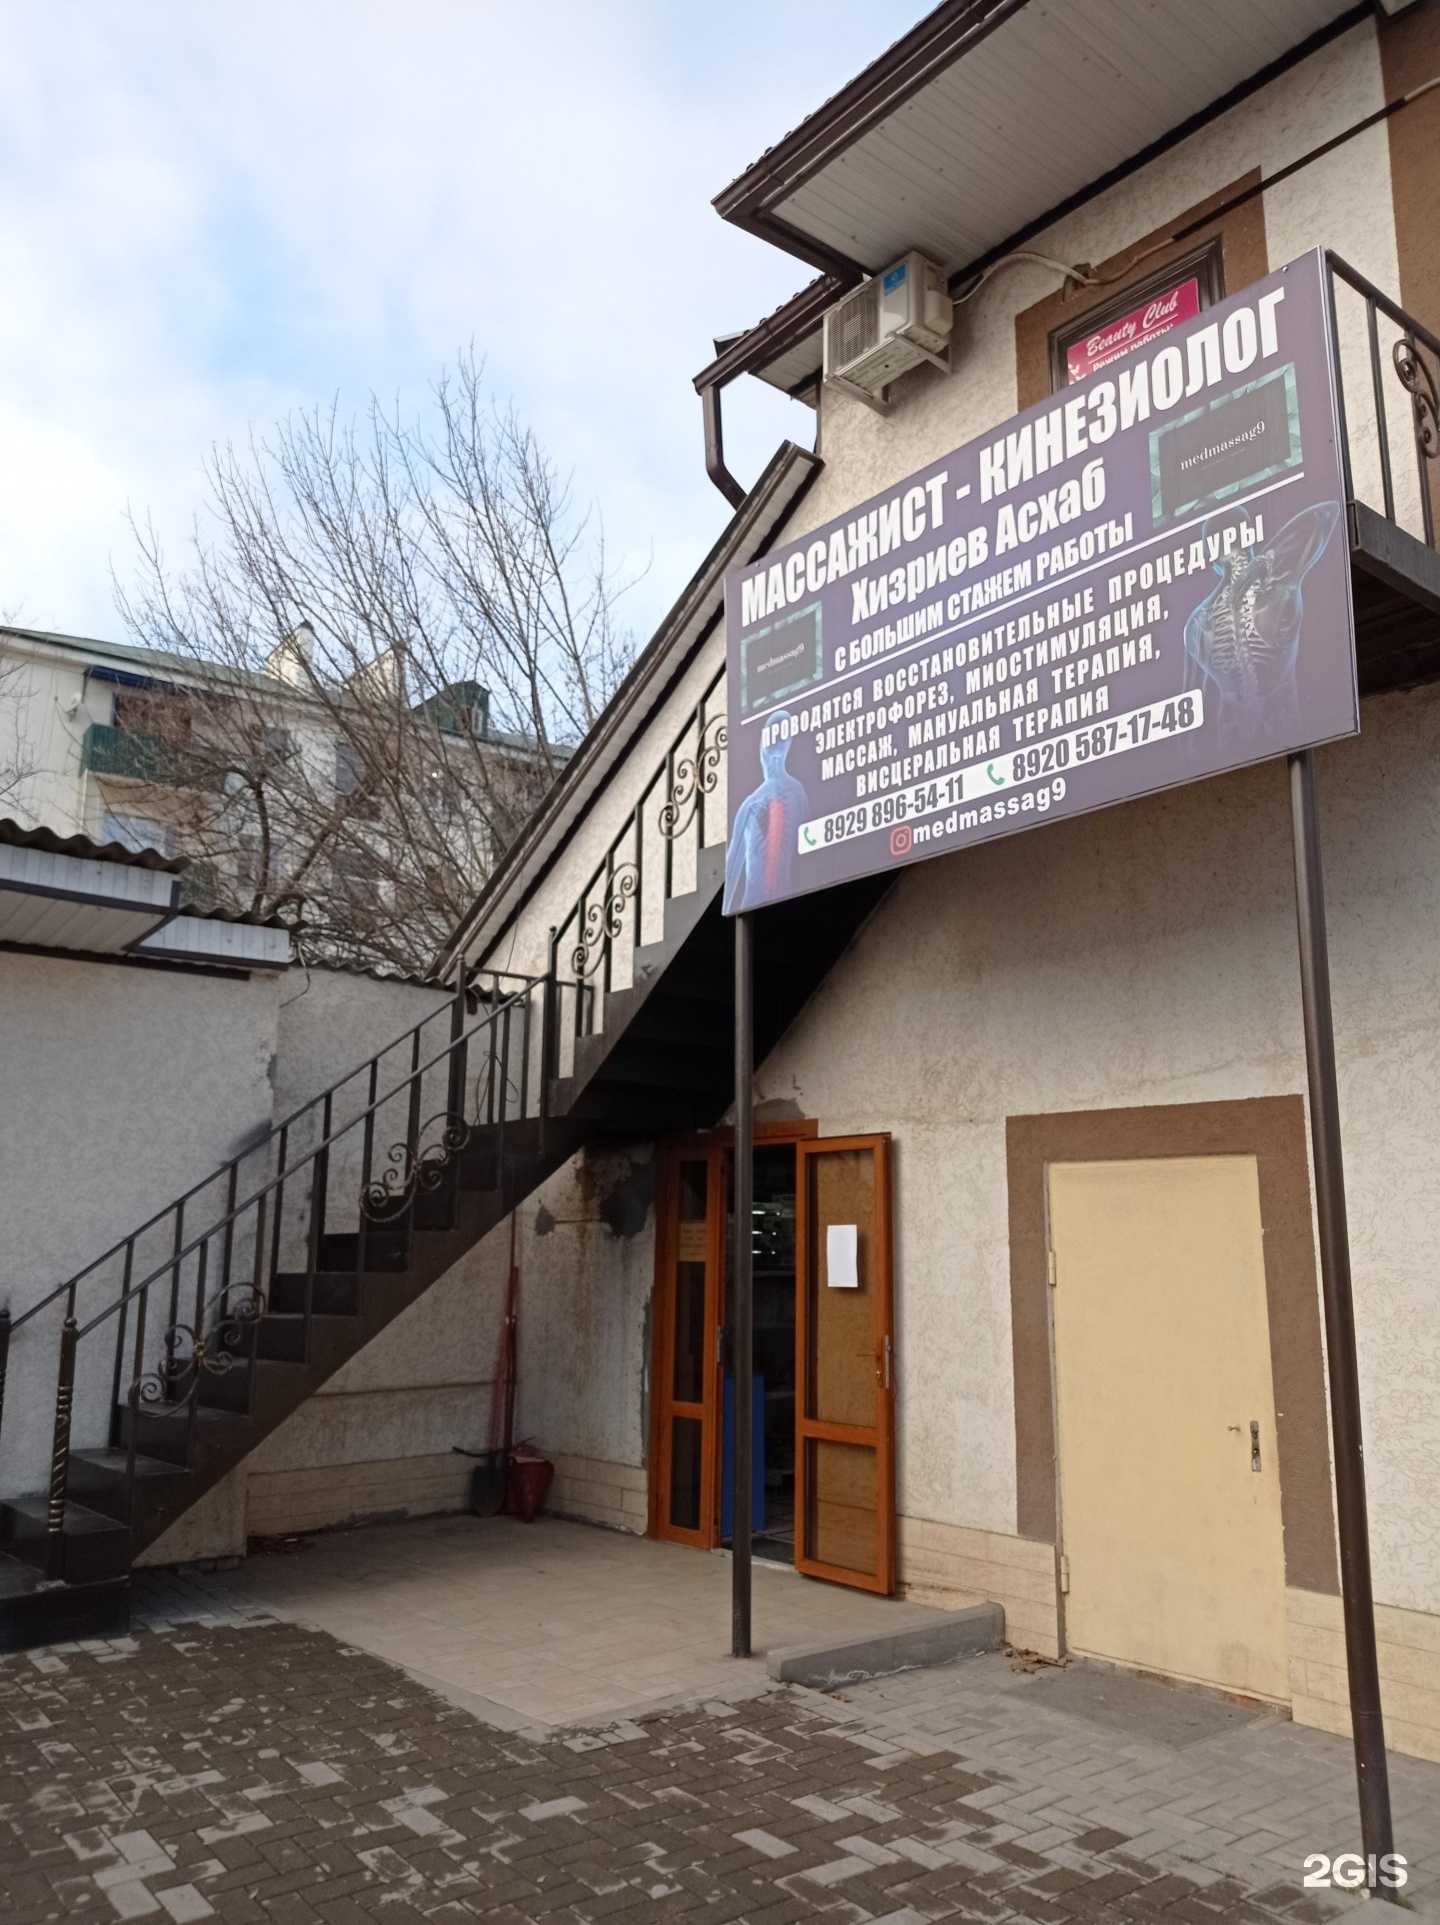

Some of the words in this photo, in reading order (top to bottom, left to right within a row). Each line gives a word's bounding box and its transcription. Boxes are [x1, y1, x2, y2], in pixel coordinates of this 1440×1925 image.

[1086, 320, 1136, 357] Beauty
[1142, 291, 1178, 328] Club
[742, 471, 948, 627] МАССАЖИСТ
[979, 287, 1285, 504] КИНЕЗИОЛОГ
[1180, 420, 1265, 471] medmassag9
[849, 600, 944, 666] БОЛЬШИМ
[947, 559, 1032, 621] СТАЖЕМ
[1036, 512, 1133, 581] РАБОТЫ
[851, 526, 988, 625] Хизриев
[995, 457, 1106, 556] Асхаб
[761, 687, 863, 749] ПРОВОДЯТСЯ
[872, 587, 1094, 702] ВОССТАНОВИТЕЛЬНЫЕ
[1108, 514, 1264, 603] ПРОЦЕДУРЫ
[815, 682, 954, 754] ЭЛЕКТРОФОРЕЗ,
[965, 594, 1168, 695] МИОСТИМУЛЯЦИЯ,
[821, 734, 898, 781] МАССАЖ,
[908, 677, 1038, 748] МАНУАЛЬНАЯ
[1052, 633, 1161, 694] ТЕРАПИЯ,
[856, 725, 1000, 798] ВИСЦЕРАЛЬНАЯ
[1012, 685, 1110, 742] ТЕРАПИЯ
[1012, 739, 1070, 782] 8920
[1075, 696, 1195, 760] 587-17-48
[824, 807, 868, 843] 8929
[871, 774, 964, 828] 896-54-11
[913, 777, 1067, 844] medmassag9
